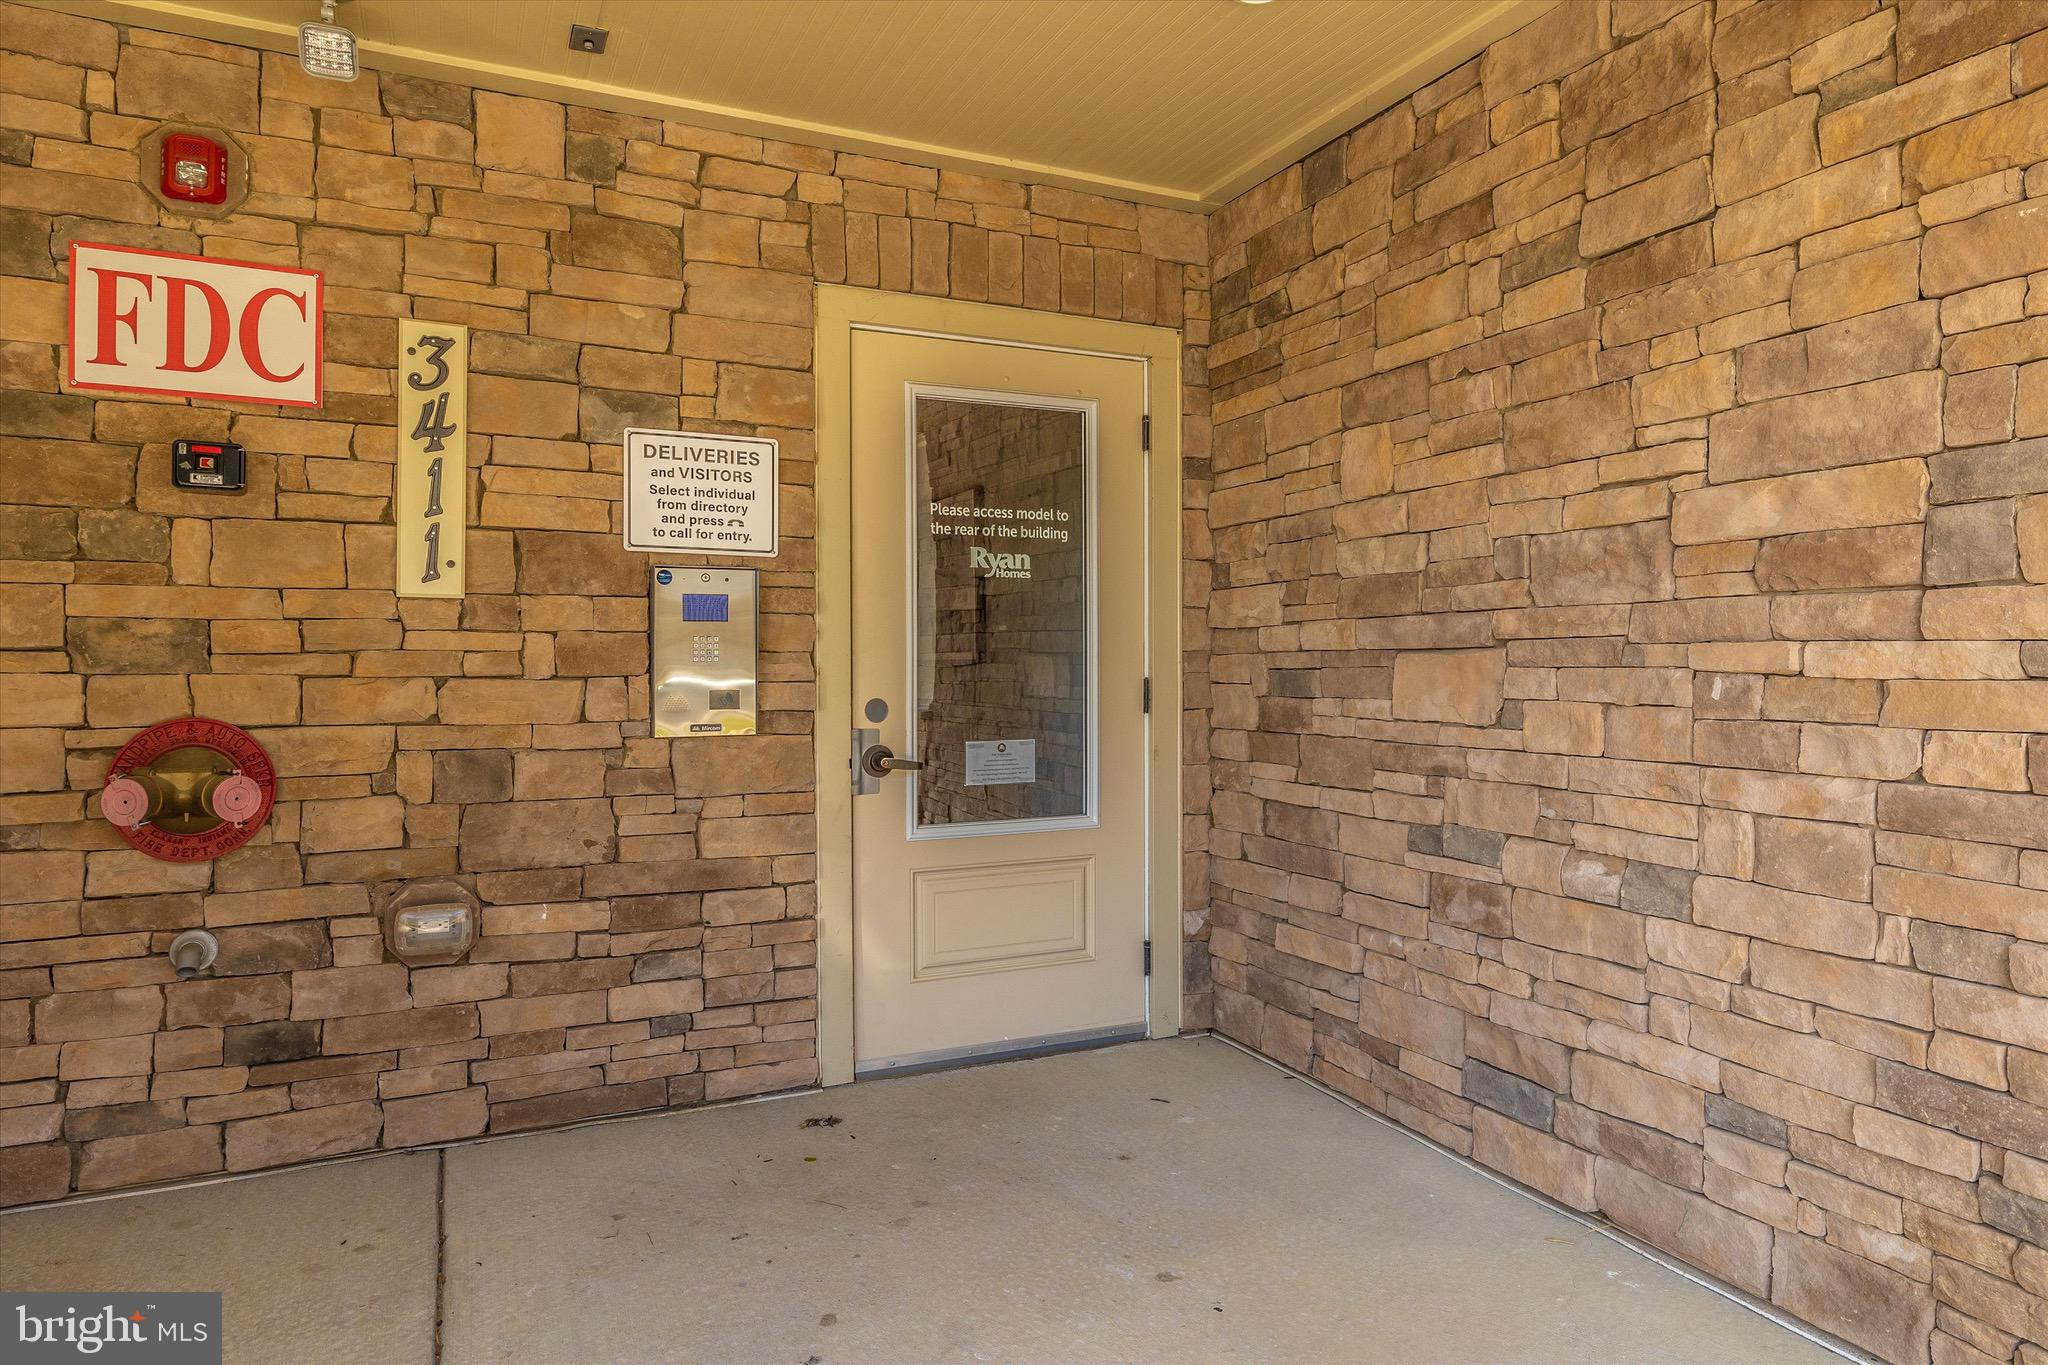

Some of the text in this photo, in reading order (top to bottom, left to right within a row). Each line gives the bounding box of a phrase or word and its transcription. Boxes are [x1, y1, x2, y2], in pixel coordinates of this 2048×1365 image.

[86, 267, 307, 383] FDC
[407, 334, 457, 584] 3411
[643, 443, 760, 466] DELIVERIES
[650, 467, 753, 483] and VISITORS
[649, 484, 755, 501] Select individual
[657, 498, 748, 516] from directory
[930, 502, 1069, 521] Please access model to
[661, 513, 724, 527] and press
[653, 527, 752, 544] to call for entry.
[930, 522, 1068, 543] the rear of the building
[969, 546, 1031, 578] Ryan
[996, 568, 1032, 579] Homes
[204, 725, 247, 750] AUTO
[133, 831, 165, 853] FIRE
[170, 846, 213, 858] DEPT.
